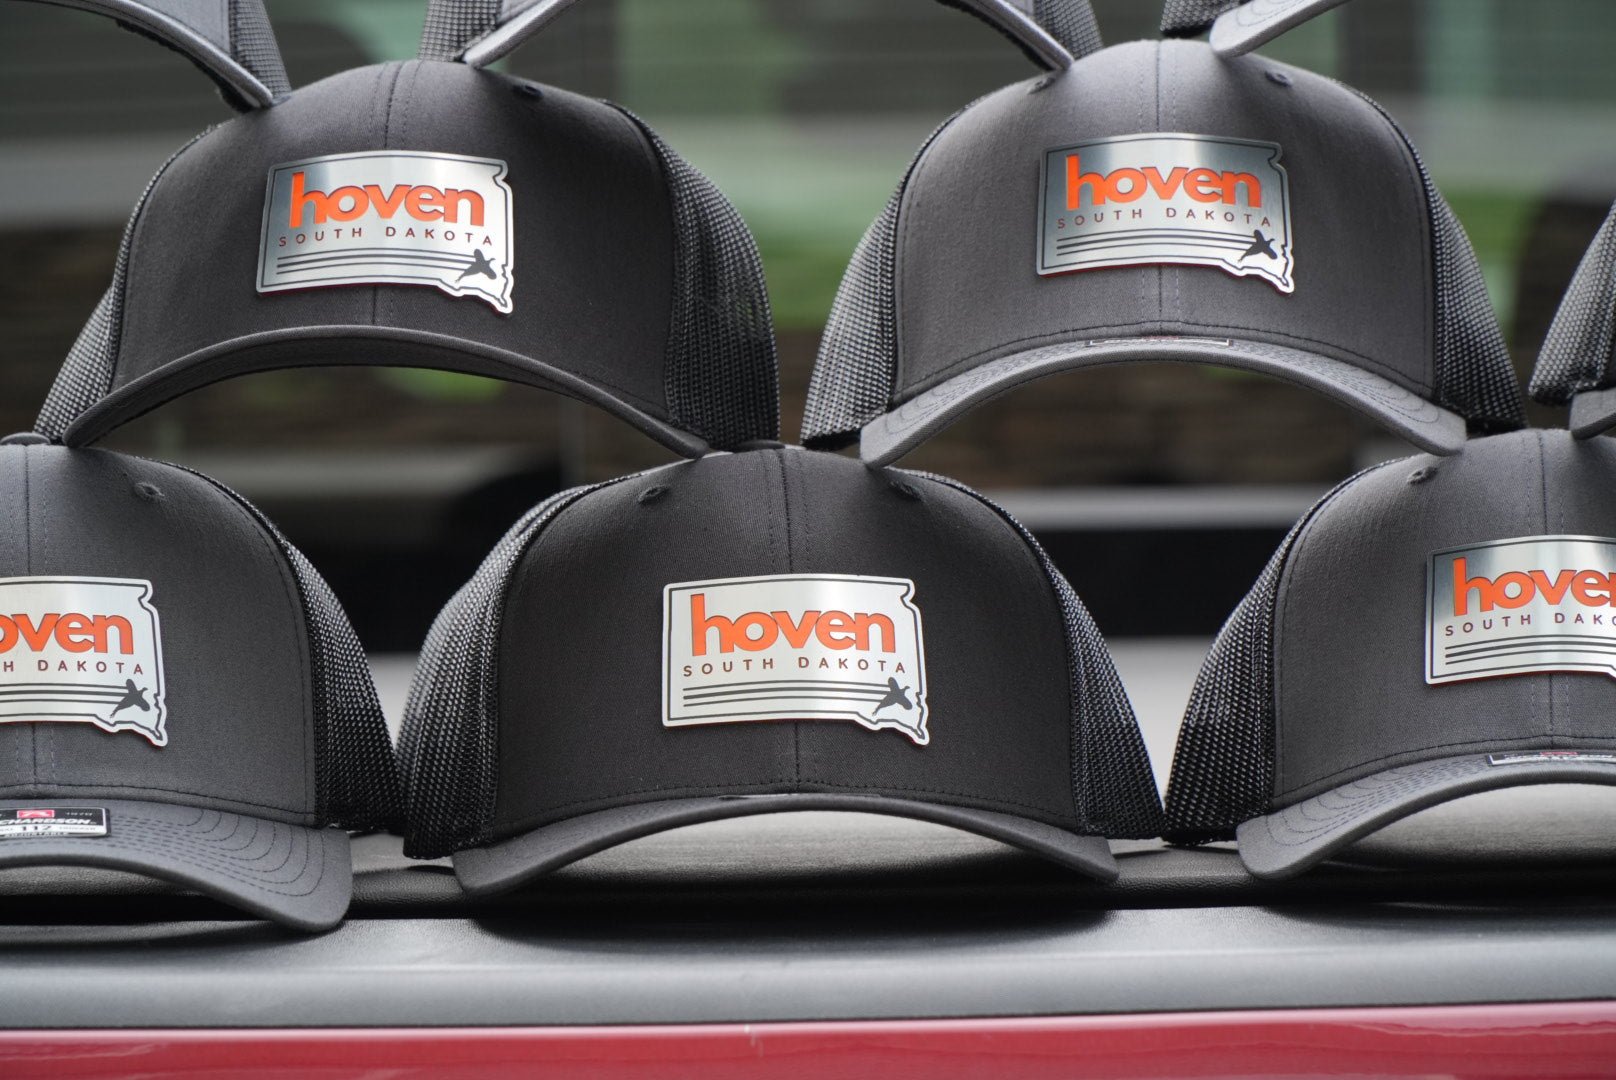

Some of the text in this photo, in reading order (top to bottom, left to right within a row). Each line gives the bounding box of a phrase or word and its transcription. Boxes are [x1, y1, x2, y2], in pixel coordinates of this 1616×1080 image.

[1066, 153, 1262, 210] hoven
[289, 171, 485, 228] hoven
[1057, 207, 1271, 229] SOUTH DAKOTA
[278, 226, 492, 247] SOUTH DAKOTA
[1453, 556, 1616, 617] hove
[690, 593, 896, 657] hoven
[1445, 614, 1531, 636] SOUTH
[37, 659, 143, 675] DAKOTA
[683, 656, 905, 677] SOUTH DAKOTA
